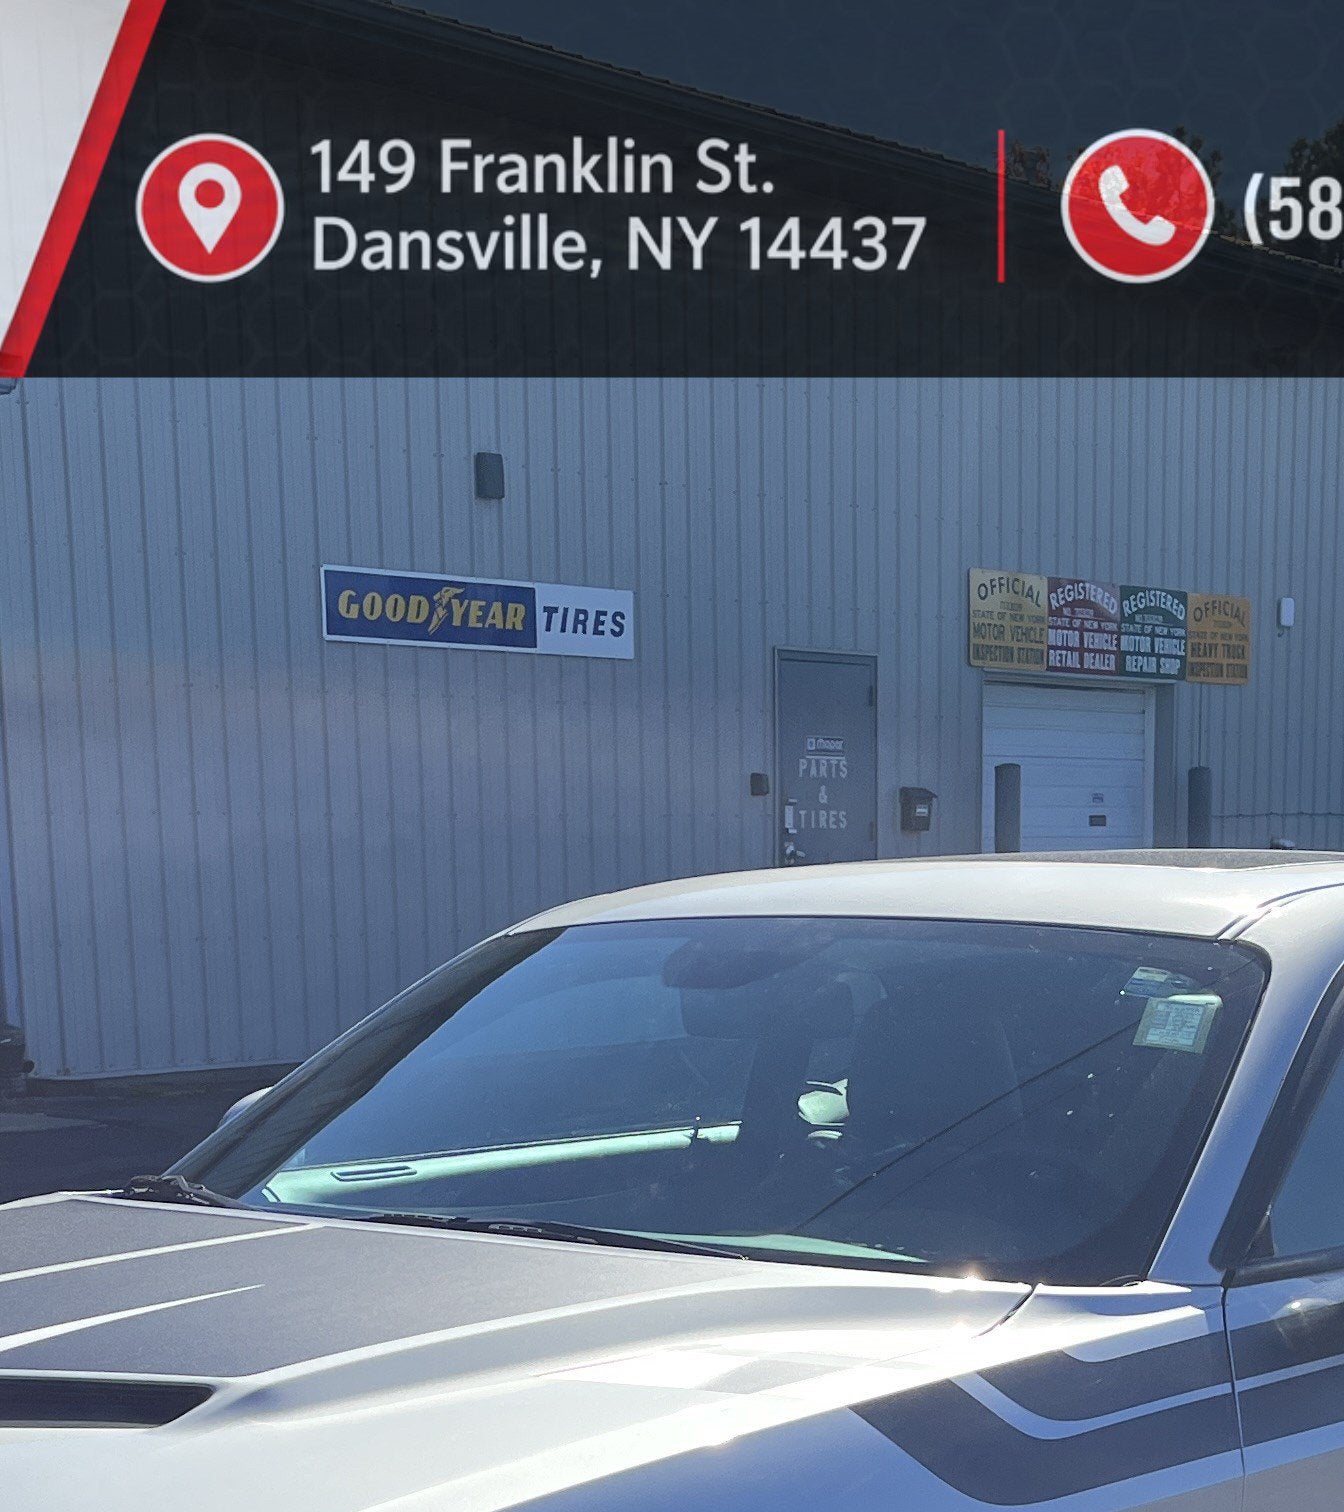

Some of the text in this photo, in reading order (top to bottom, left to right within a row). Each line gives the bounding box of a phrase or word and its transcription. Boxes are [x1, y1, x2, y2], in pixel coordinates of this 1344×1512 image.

[977, 577, 1041, 608] OFFICIAL
[1050, 583, 1118, 614] REGISTERED
[1122, 590, 1186, 621] REGISTERED
[1193, 600, 1246, 628] OFFICIAL
[542, 606, 626, 638] TIRES
[972, 622, 1045, 645] MOTOR VEHICLE
[1048, 628, 1118, 651] MOTOR VEHICLE
[1120, 635, 1186, 656] MOTOR VEHICLE
[1190, 641, 1245, 660] HEAVY TRUCK
[1048, 649, 1116, 671] RETAIL DEALER
[1125, 655, 1181, 675] REPAIR SHOP
[798, 758, 848, 779] PARTS
[818, 785, 829, 804] &
[799, 809, 848, 829] TIRES
